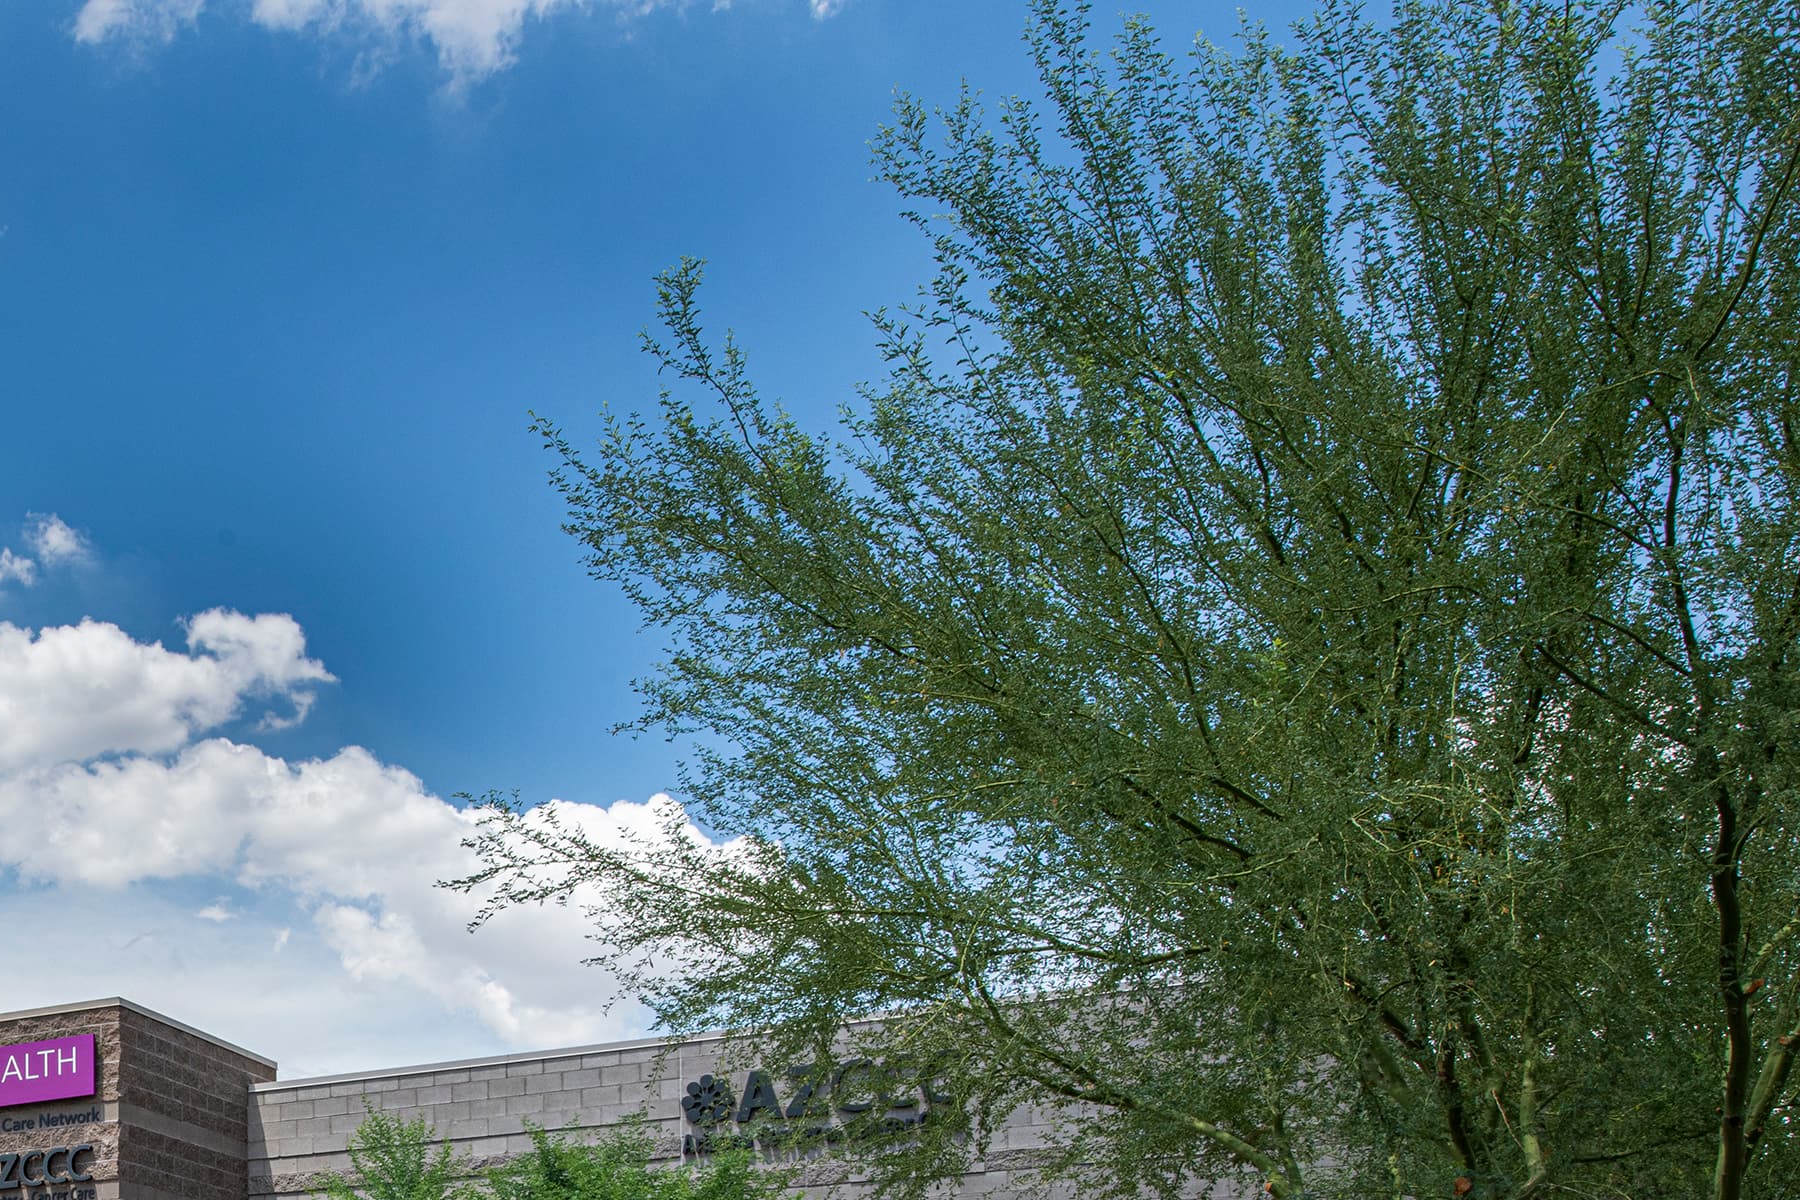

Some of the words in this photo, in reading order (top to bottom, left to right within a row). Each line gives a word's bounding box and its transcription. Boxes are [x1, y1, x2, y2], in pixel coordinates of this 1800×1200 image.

[2, 1118, 35, 1132] Care
[39, 1106, 100, 1128] Network
[71, 1187, 95, 1200] Care
